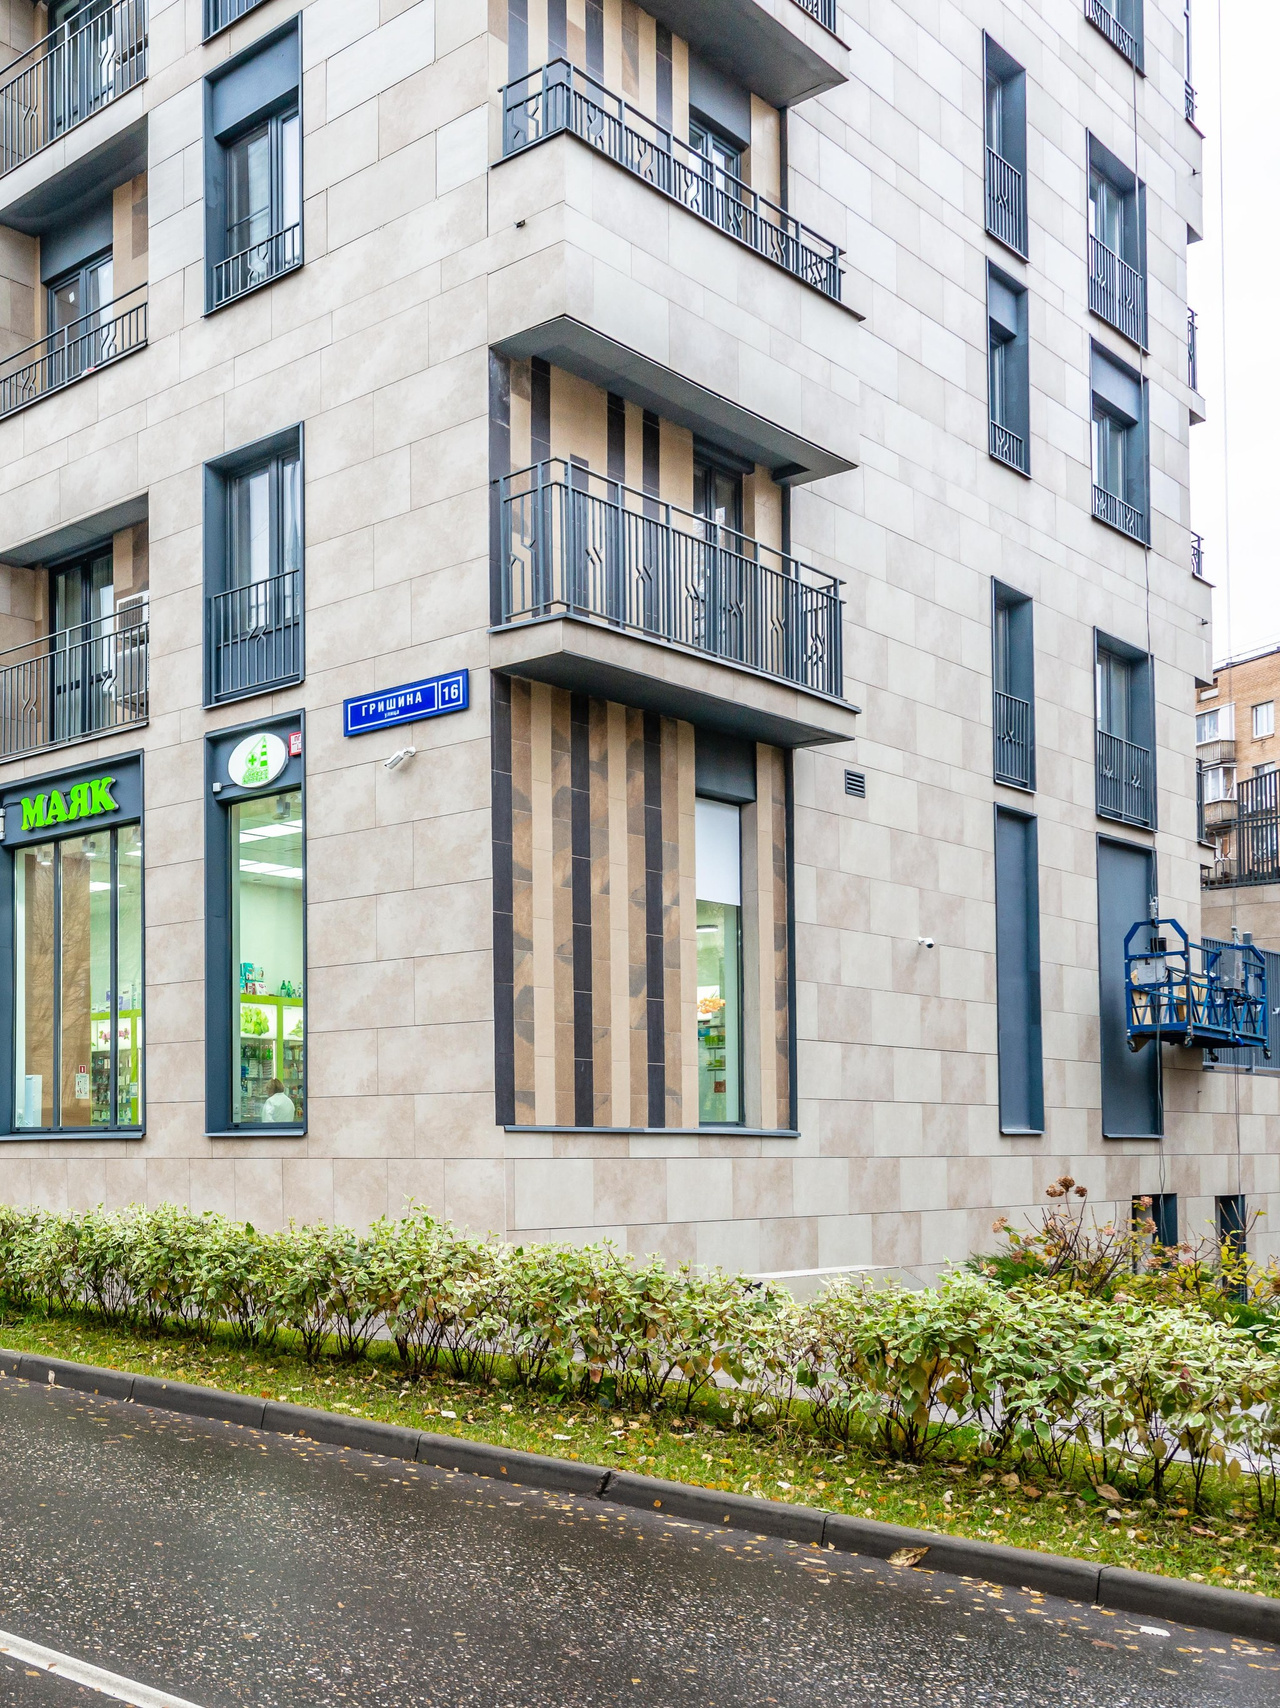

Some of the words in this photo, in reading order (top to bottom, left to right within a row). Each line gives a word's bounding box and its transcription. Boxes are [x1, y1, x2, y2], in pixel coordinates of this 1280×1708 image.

[361, 691, 423, 717] ГРИШИНА
[442, 683, 459, 701] 16
[384, 709, 400, 718] улица
[20, 776, 117, 831] МАЯК
